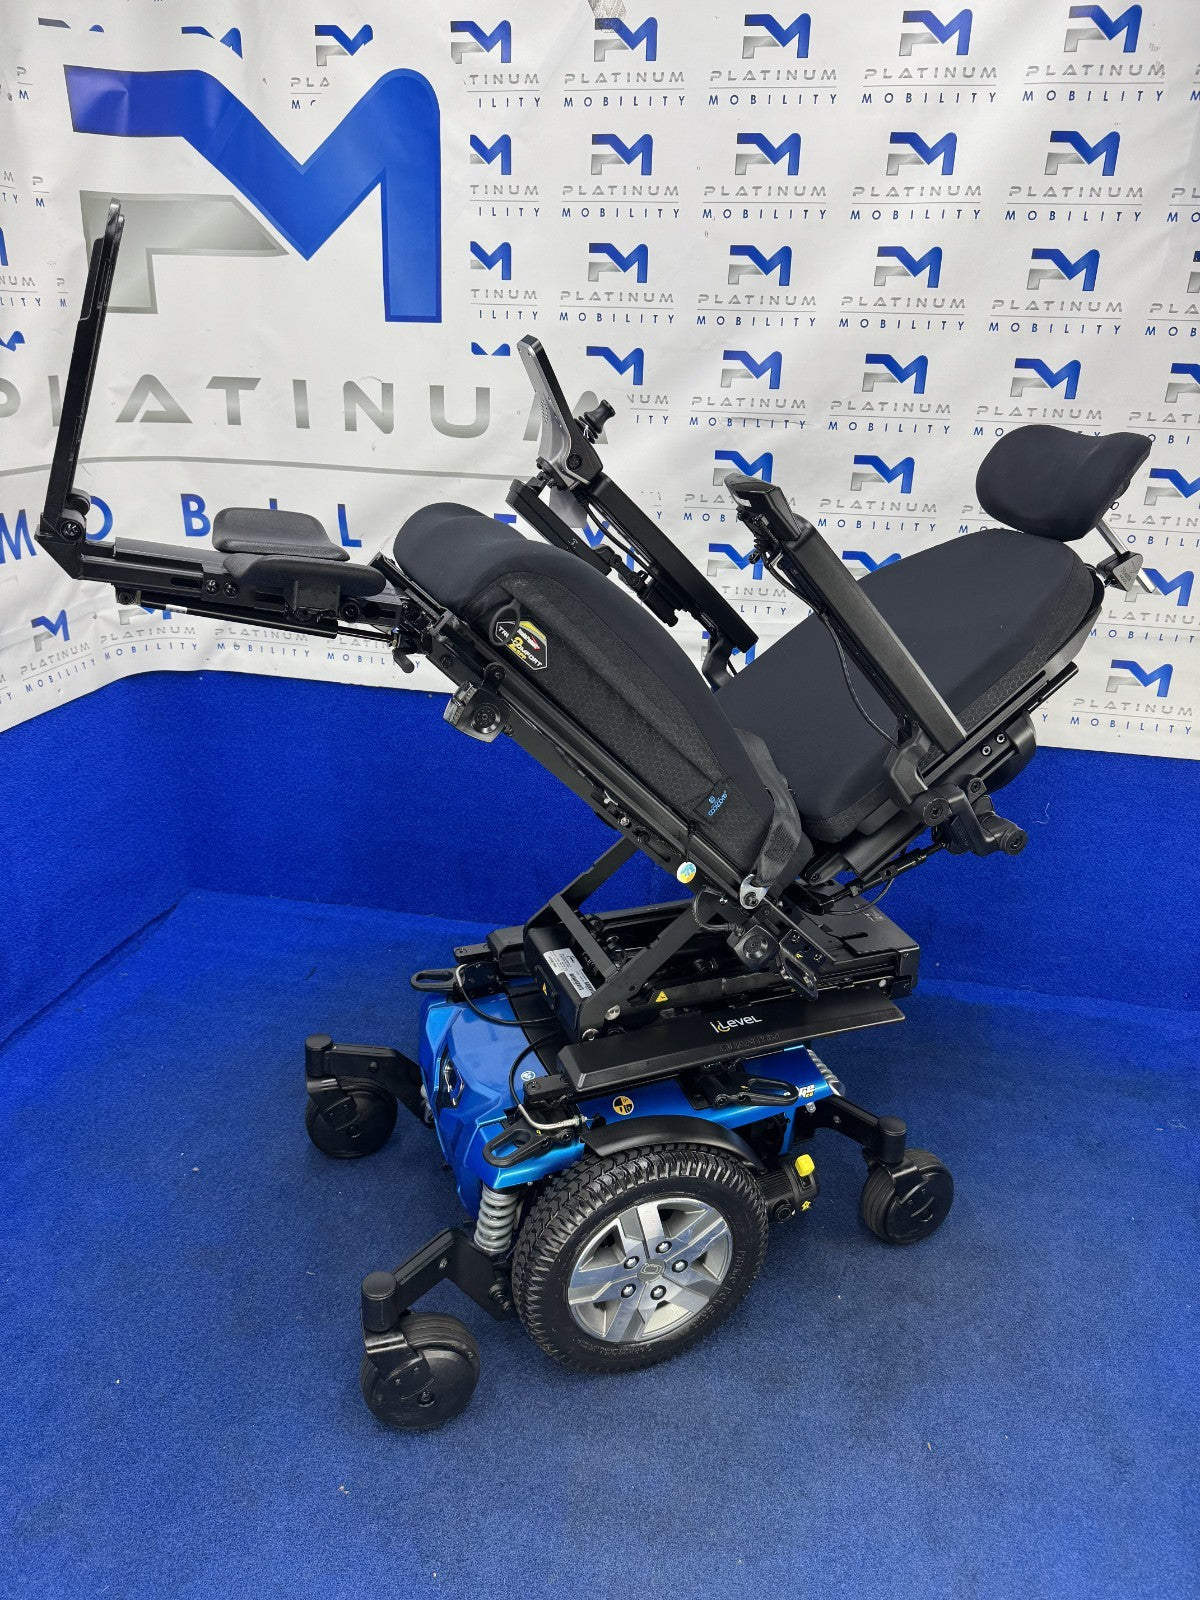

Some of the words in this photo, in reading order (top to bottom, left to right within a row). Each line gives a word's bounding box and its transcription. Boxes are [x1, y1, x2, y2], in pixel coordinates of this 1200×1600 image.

[709, 69, 838, 82] PLATINUM
[864, 67, 998, 81] PLATINUM
[1025, 63, 1165, 77] PLATINUM
[464, 73, 539, 85] TINUM
[564, 71, 684, 84] PLATINUM
[563, 96, 685, 107] MOBILITY
[708, 94, 837, 106] MOBILITY
[861, 92, 997, 104] MOBILITY
[1022, 90, 1165, 102] MOBILITY
[562, 184, 679, 197] PLATINUM
[704, 185, 827, 198] PLATINUM
[852, 185, 982, 198] PLATINUM
[1008, 185, 1144, 199] PLATINUM
[561, 207, 680, 219] MOBILITY
[702, 208, 827, 220] MOBILITY
[850, 209, 981, 221] MOBILITY
[1004, 210, 1143, 223] MOBILITY
[560, 291, 674, 303] PLATINUM
[698, 294, 817, 306] PLATINUM
[841, 296, 966, 309] PLATINUM
[991, 299, 1123, 313] PLATINUM
[560, 312, 675, 324] MOBILITY
[696, 315, 816, 327] MOBILITY
[838, 318, 965, 331] MOBILITY
[988, 322, 1121, 335] MOBILITY
[692, 396, 806, 409] PLATINUM
[830, 400, 951, 414] PLATINUM
[976, 405, 1102, 420] PLATINUM
[689, 416, 807, 429] MOBILITY
[828, 421, 951, 435] MOBILITY
[819, 499, 938, 513] PLATINUM
[817, 518, 937, 532] MOBILITY
[100, 627, 196, 644] PLATINUM
[215, 628, 308, 642] PLATINUM
[104, 643, 197, 660] MOBILITY
[20, 642, 90, 675] PLATINUM
[1073, 698, 1192, 716] PLATINUM
[1069, 716, 1192, 734] MOBILITY
